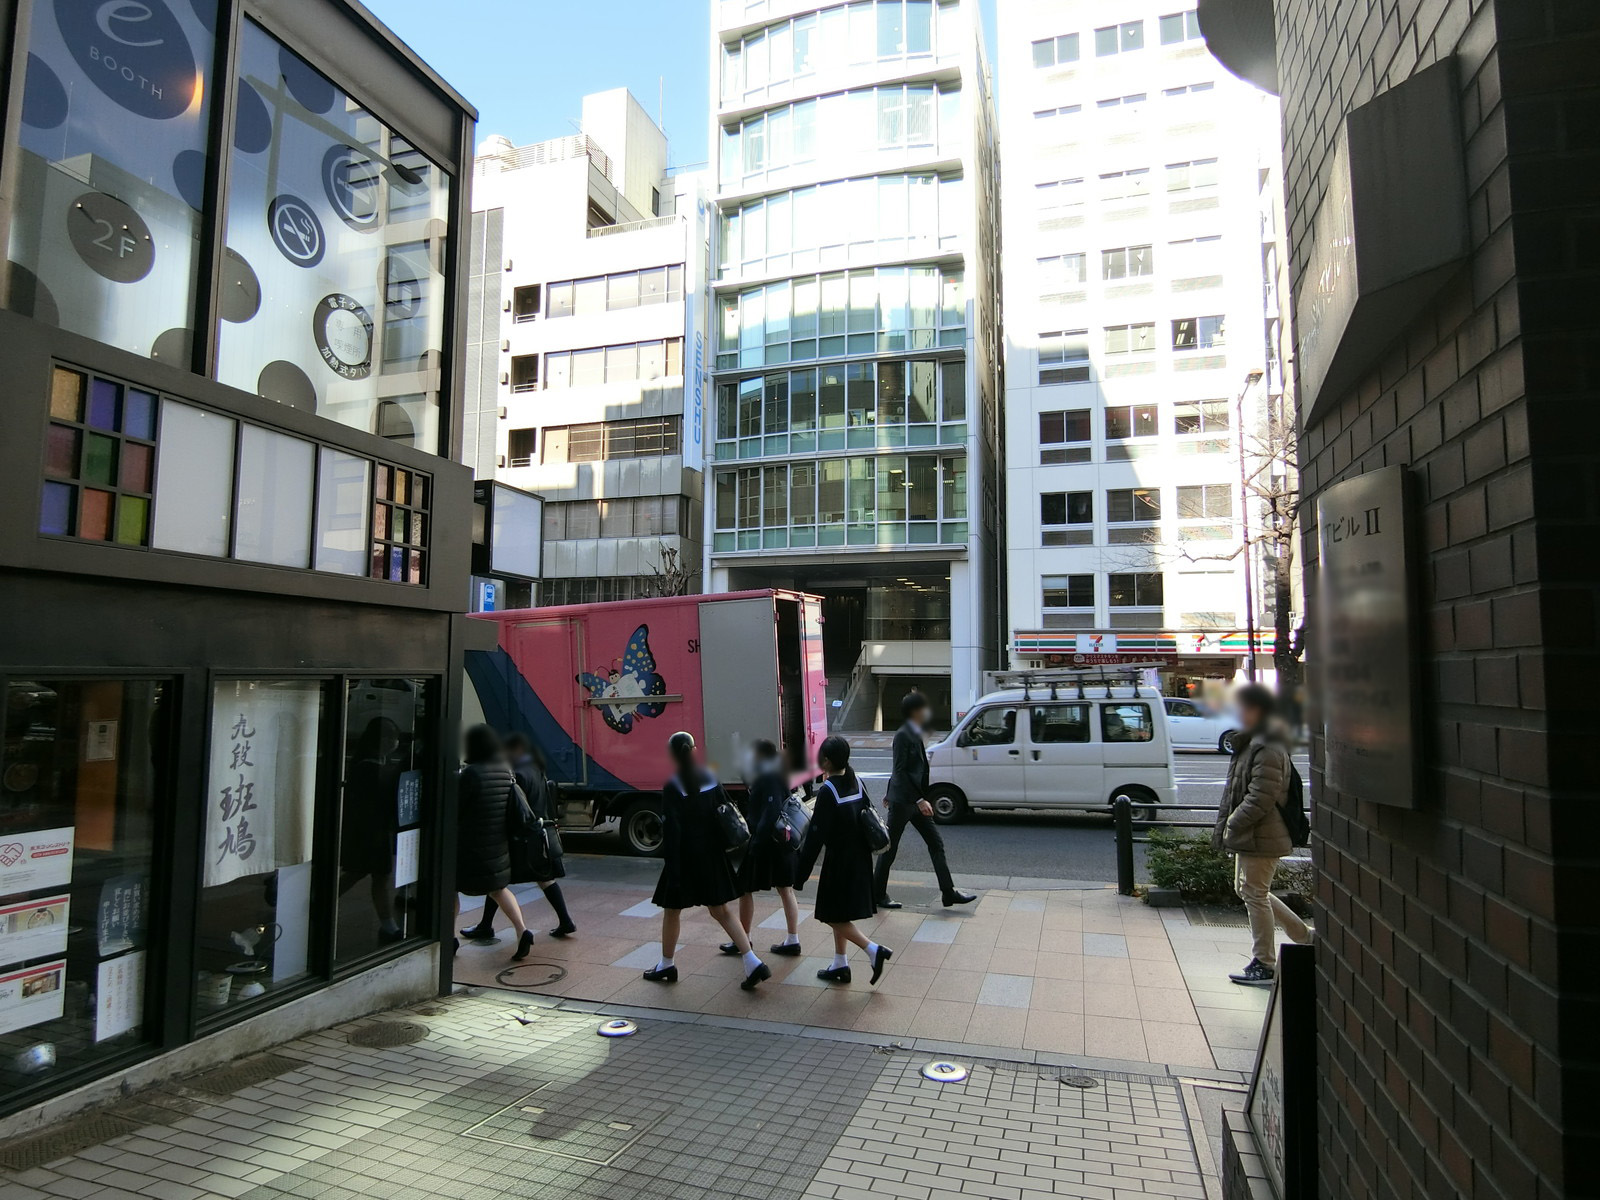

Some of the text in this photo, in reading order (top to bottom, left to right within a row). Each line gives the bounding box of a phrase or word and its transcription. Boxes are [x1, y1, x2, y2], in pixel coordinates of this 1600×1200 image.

[90, 46, 163, 100] BOOTH
[92, 219, 136, 258] 2F
[694, 330, 702, 444] SENSHU
